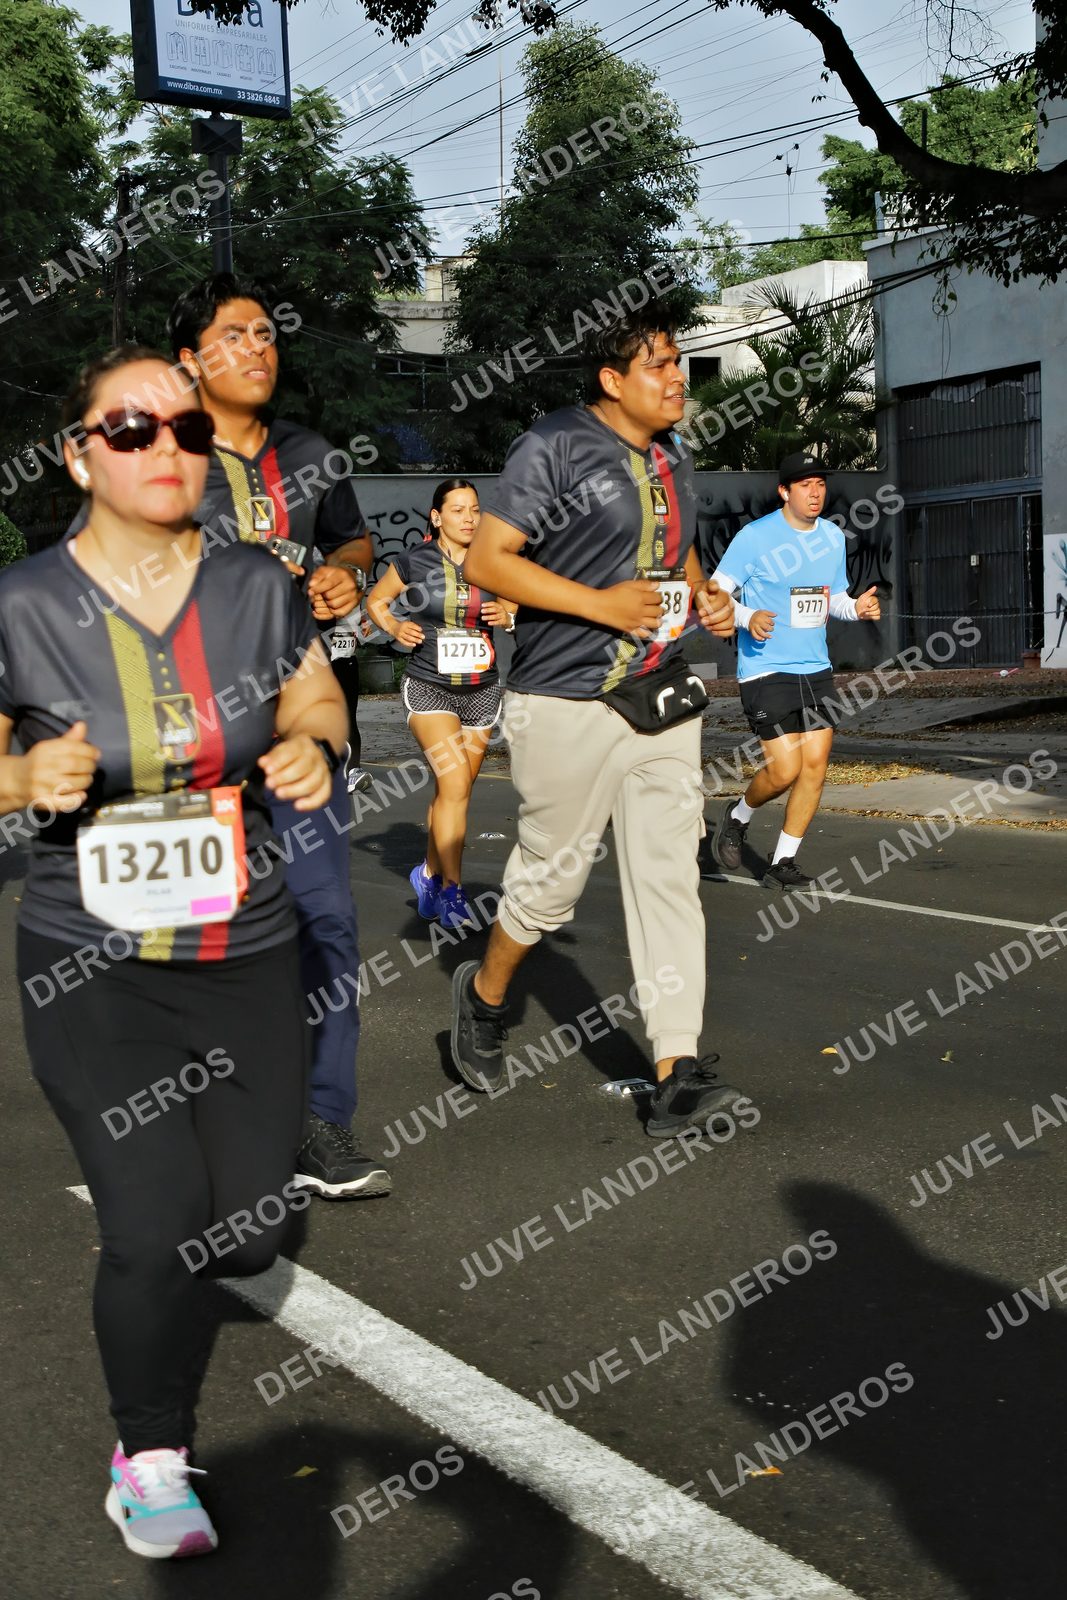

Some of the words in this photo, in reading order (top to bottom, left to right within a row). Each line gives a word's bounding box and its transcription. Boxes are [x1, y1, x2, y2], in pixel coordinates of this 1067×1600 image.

[175, 19, 215, 33] UNIFORMES
[167, 79, 223, 95] www.dibra.com.mx
[237, 90, 246, 99] 33
[246, 91, 263, 102] 3826
[263, 94, 281, 105] 4845
[797, 600, 823, 613] 9777
[441, 643, 487, 657] 12715
[90, 835, 223, 884] 13210
